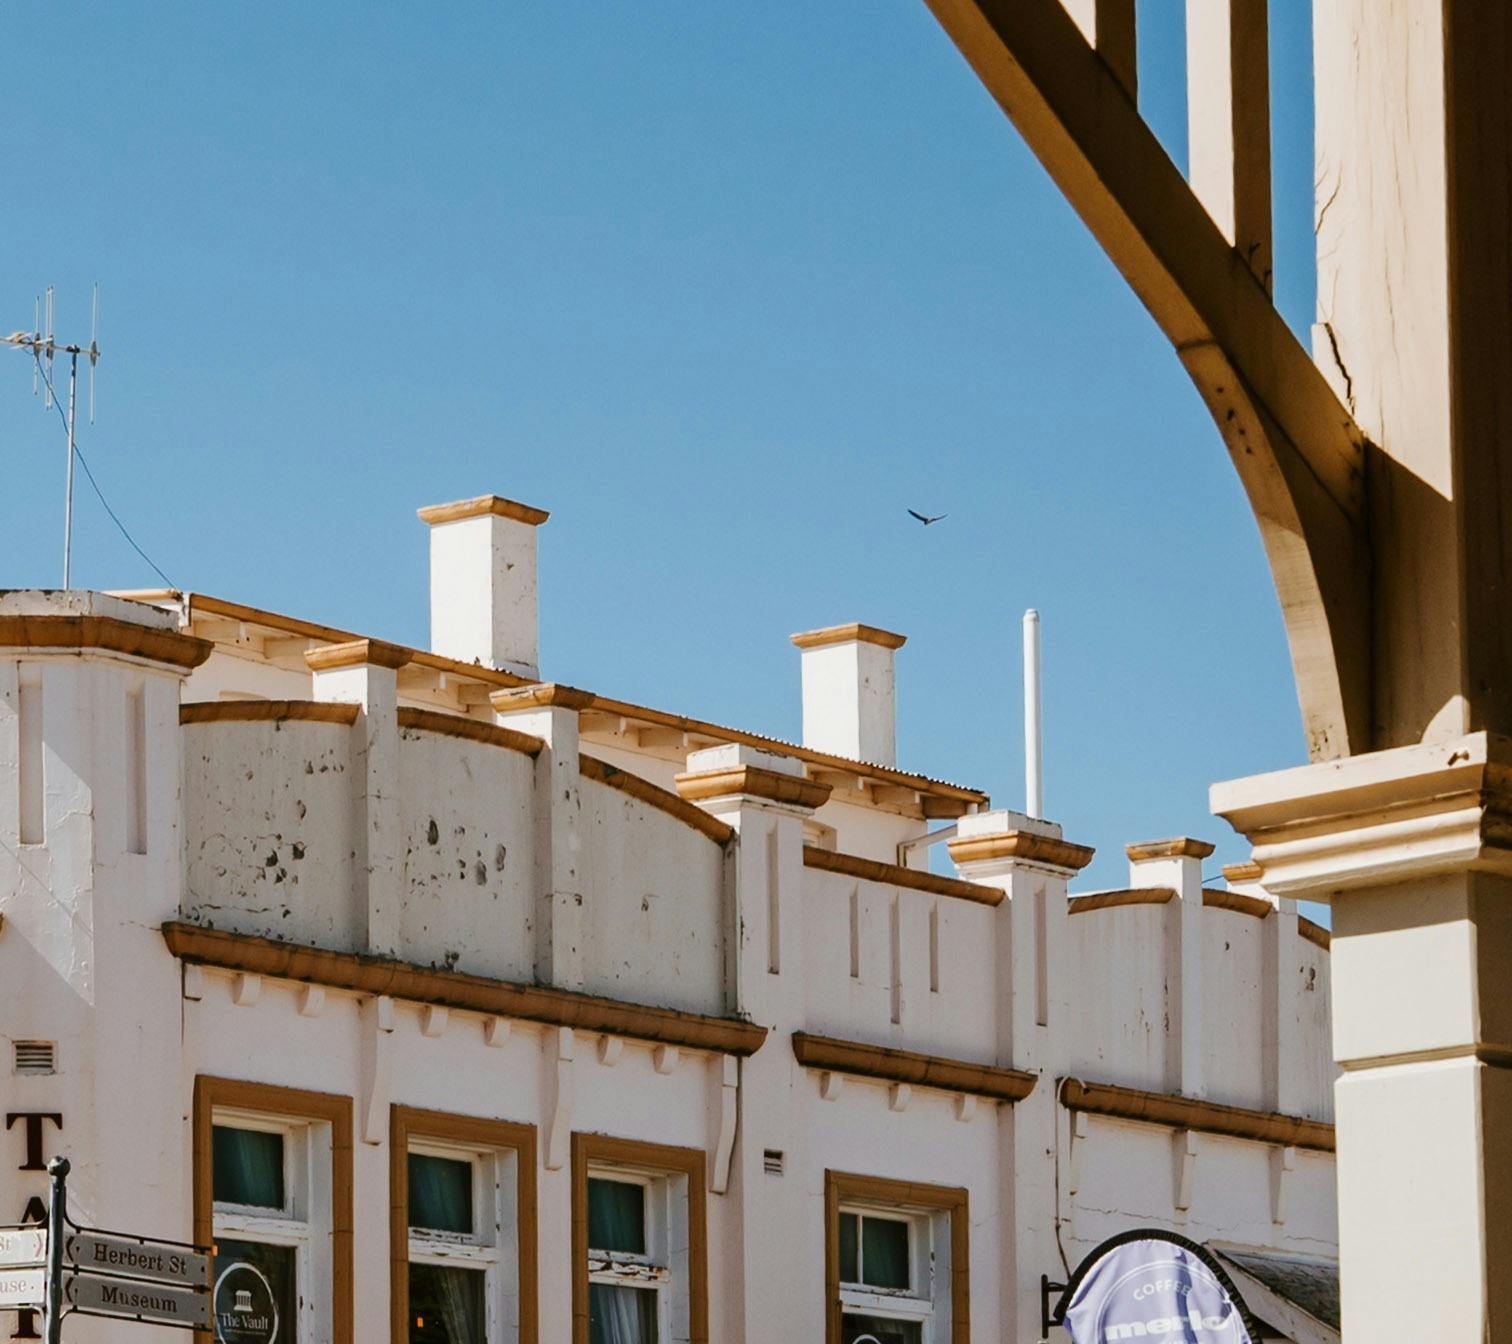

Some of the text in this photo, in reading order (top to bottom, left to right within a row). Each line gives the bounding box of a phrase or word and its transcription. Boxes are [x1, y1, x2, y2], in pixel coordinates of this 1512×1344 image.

[93, 1242, 187, 1275] Herbert St
[101, 1284, 178, 1313] Museum
[1133, 1278, 1192, 1301] COFFEE
[221, 1312, 268, 1330] The Vault
[1104, 1309, 1233, 1341] merlo
